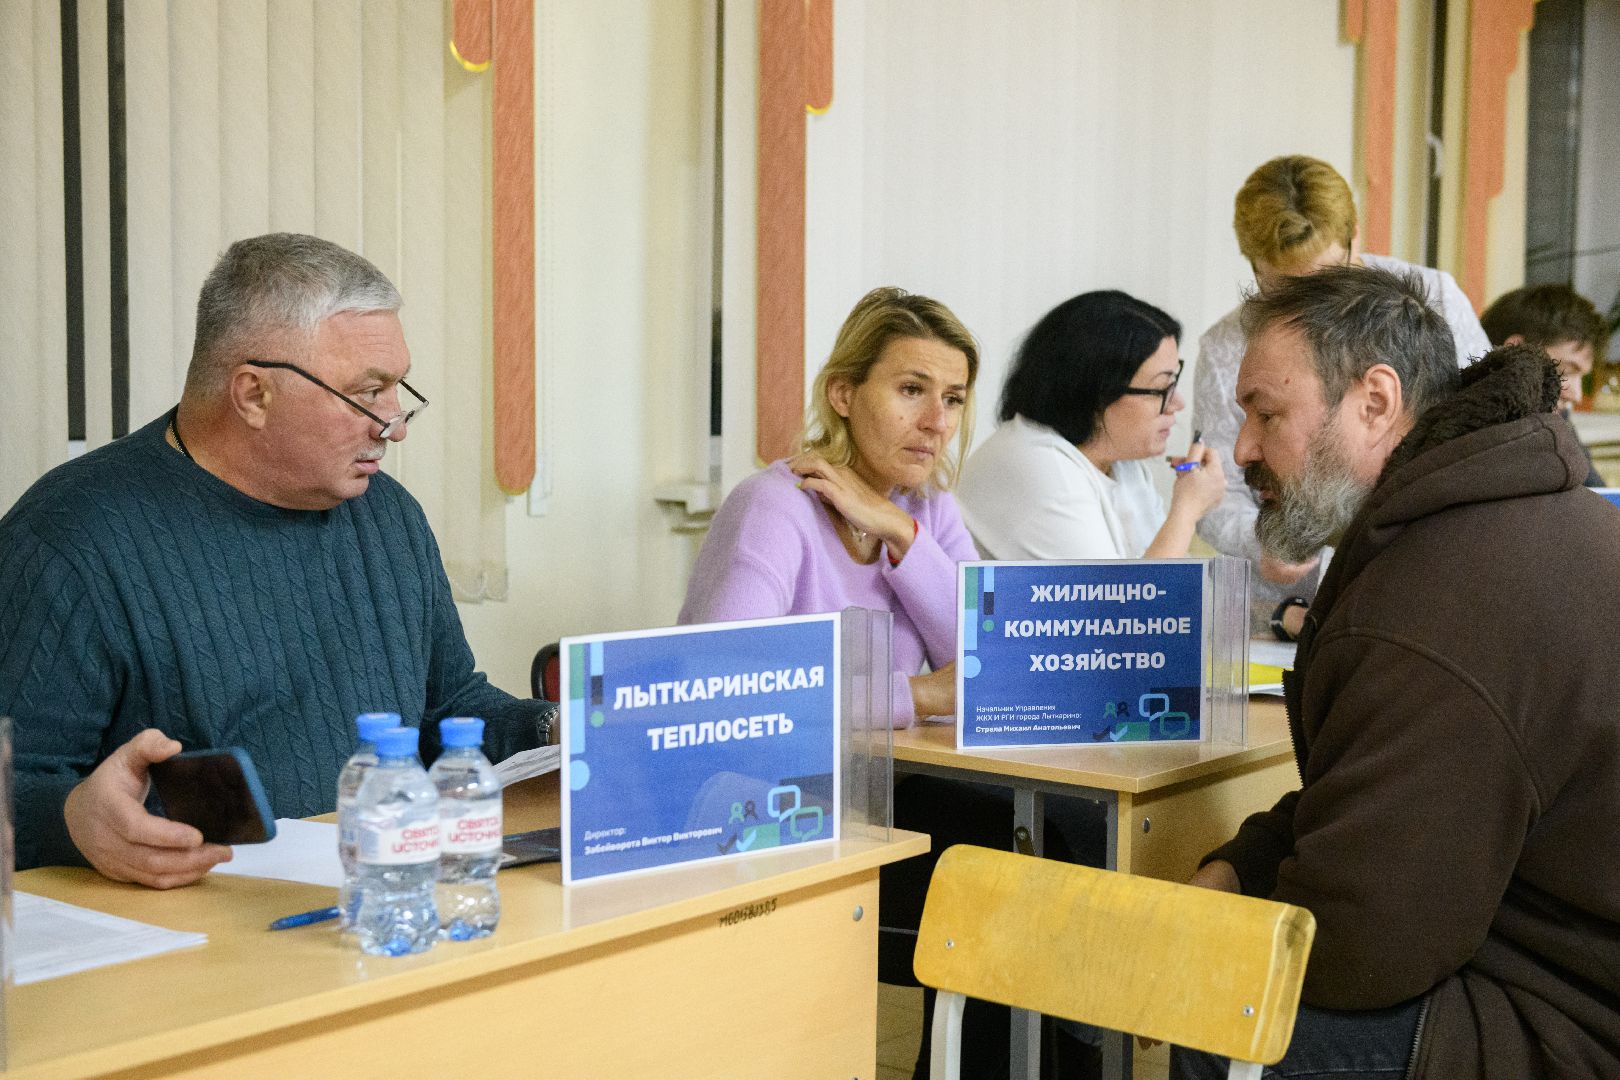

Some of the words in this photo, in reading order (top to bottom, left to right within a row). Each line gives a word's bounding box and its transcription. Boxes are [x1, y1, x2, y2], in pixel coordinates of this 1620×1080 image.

[1030, 583, 1167, 603] ЖИЛИЩНО-
[1004, 617, 1191, 637] КОММУНАЛЬНОЕ
[1029, 649, 1166, 671] ХОЗЯЙСТВО
[613, 665, 825, 710] ЛЫТКАРИНСКАЯ
[646, 712, 794, 751] ТЕПЛОСЕТЬ
[641, 834, 673, 847] Виктор
[672, 826, 722, 842] Викторович
